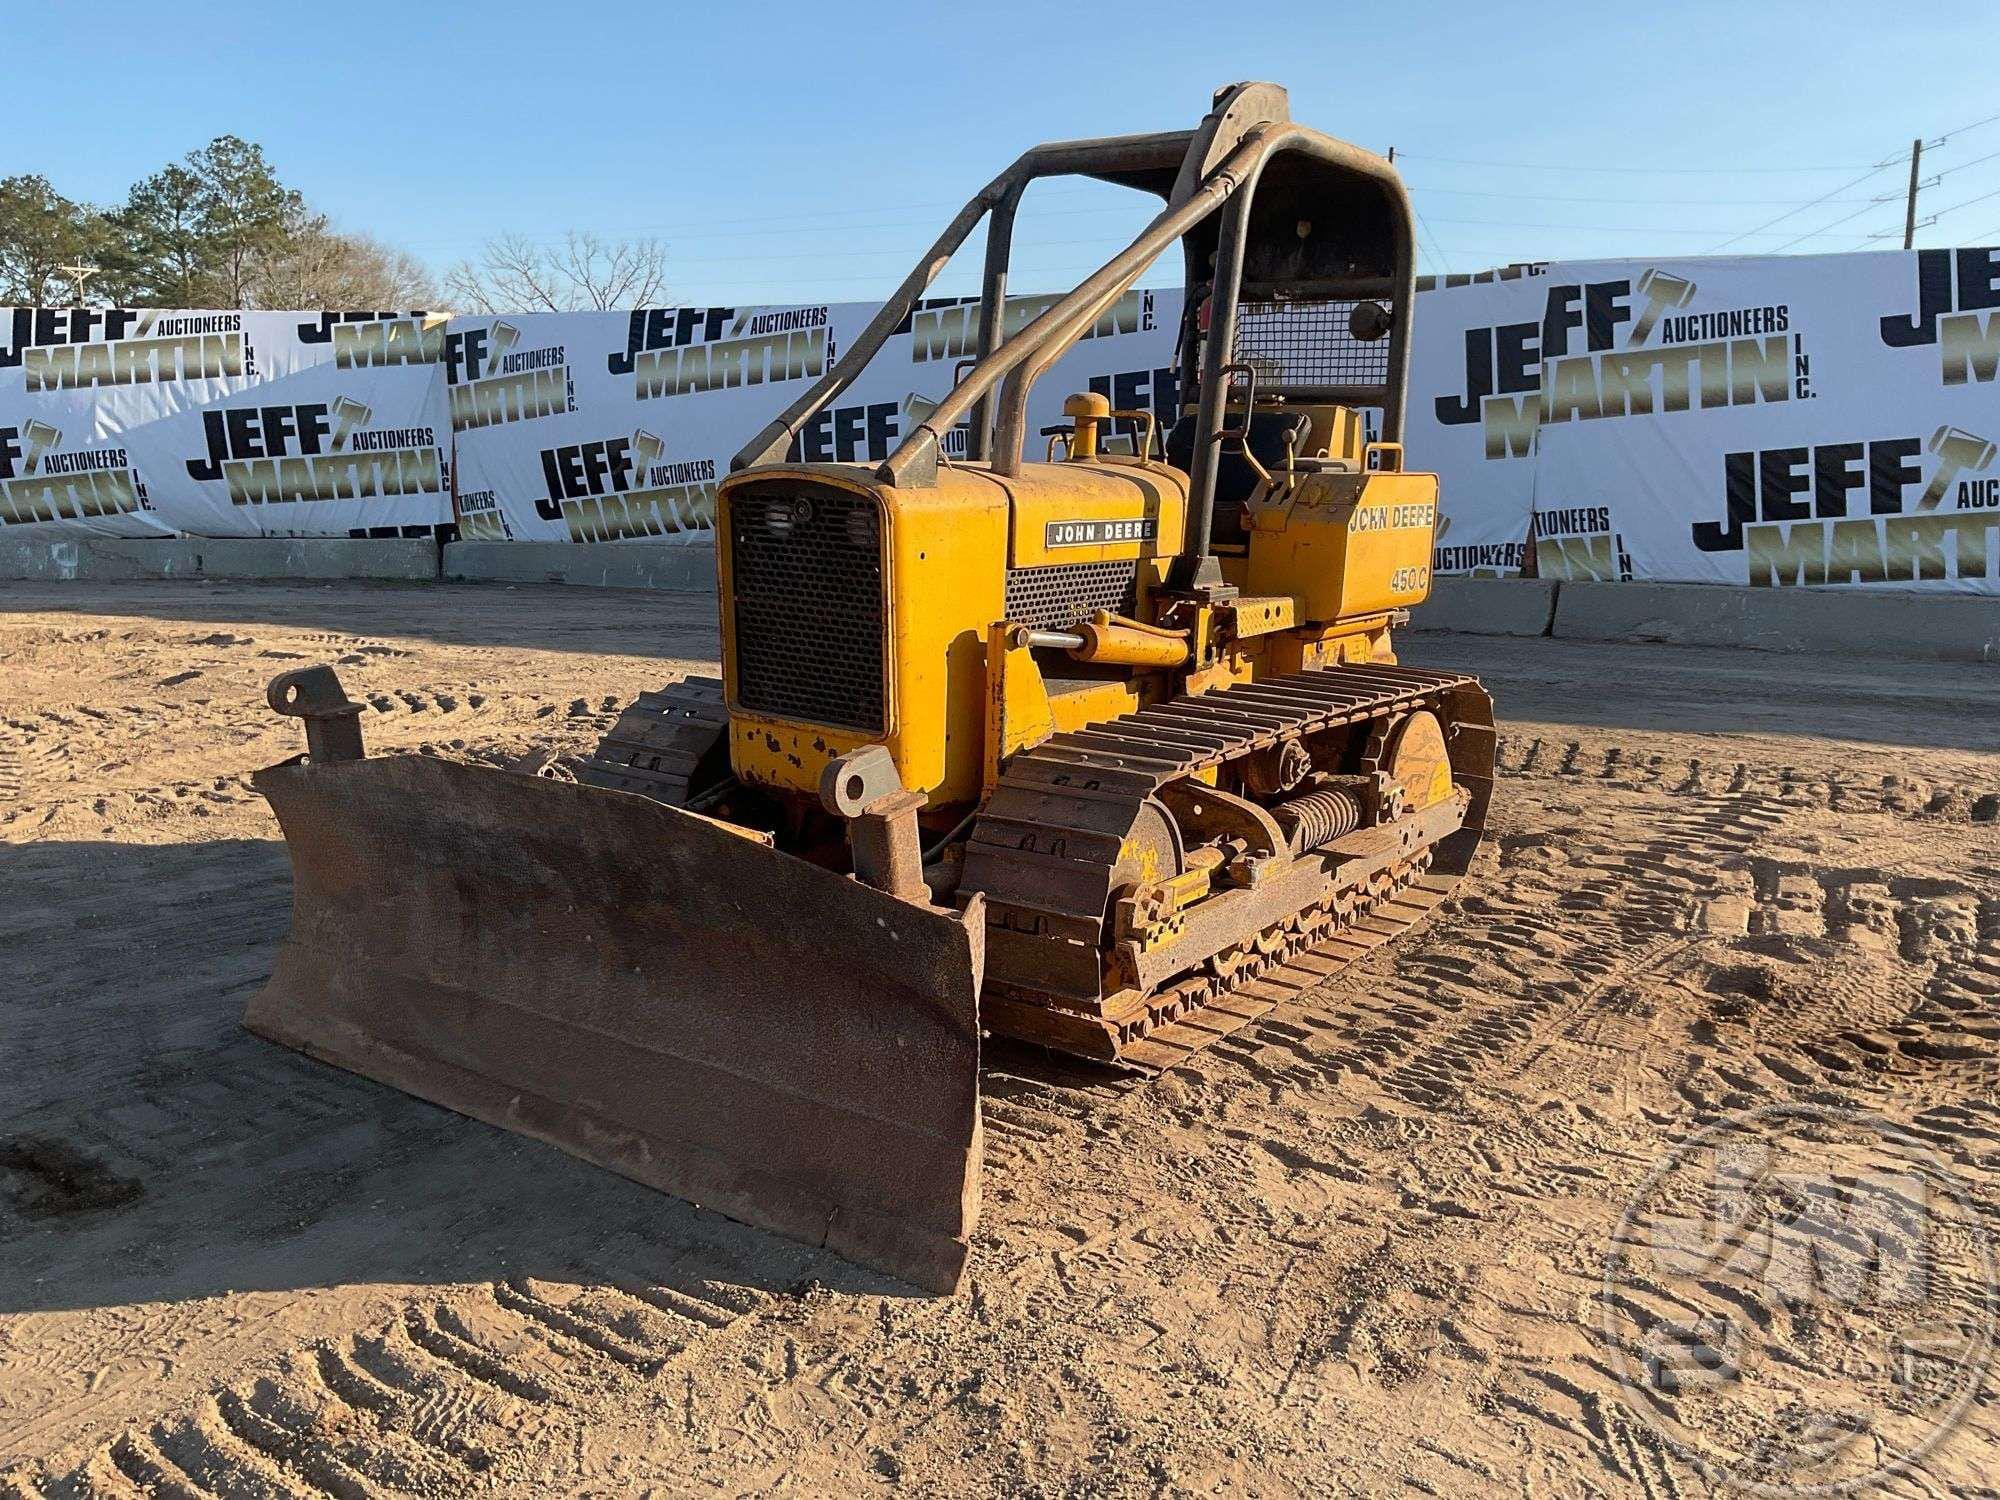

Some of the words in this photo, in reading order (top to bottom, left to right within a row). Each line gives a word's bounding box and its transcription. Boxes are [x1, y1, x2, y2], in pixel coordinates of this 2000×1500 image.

[157, 314, 241, 337] AUCTIONEERS
[750, 306, 828, 335] AUCTIONEERS
[1662, 305, 1789, 344] AUCTIONEERS
[25, 334, 241, 393] MARTIN
[243, 332, 260, 376] INC.
[503, 346, 564, 373] AUCTIONEERS
[635, 328, 825, 401] MARTIN
[1435, 280, 1630, 425] JEFF
[1794, 333, 1817, 399] INC.
[566, 365, 579, 412] INC.
[1485, 336, 1789, 460] MARTIN
[44, 449, 128, 474] AUCTIONEERS
[185, 403, 330, 480] JEFF
[352, 428, 434, 451] AUCTIONEERS
[132, 468, 157, 510] INC.
[223, 449, 439, 505] MARTIN
[535, 437, 633, 521] JEFF
[651, 459, 715, 487] AUCTIONEERS
[1692, 437, 1922, 551] JEFF
[561, 482, 717, 543] MARTIN
[1055, 525, 1095, 542] JOHN
[1104, 522, 1151, 538] DEERE
[1349, 506, 1387, 532] JOHN
[1392, 504, 1433, 528] DEERE
[1748, 511, 2000, 587] MART
